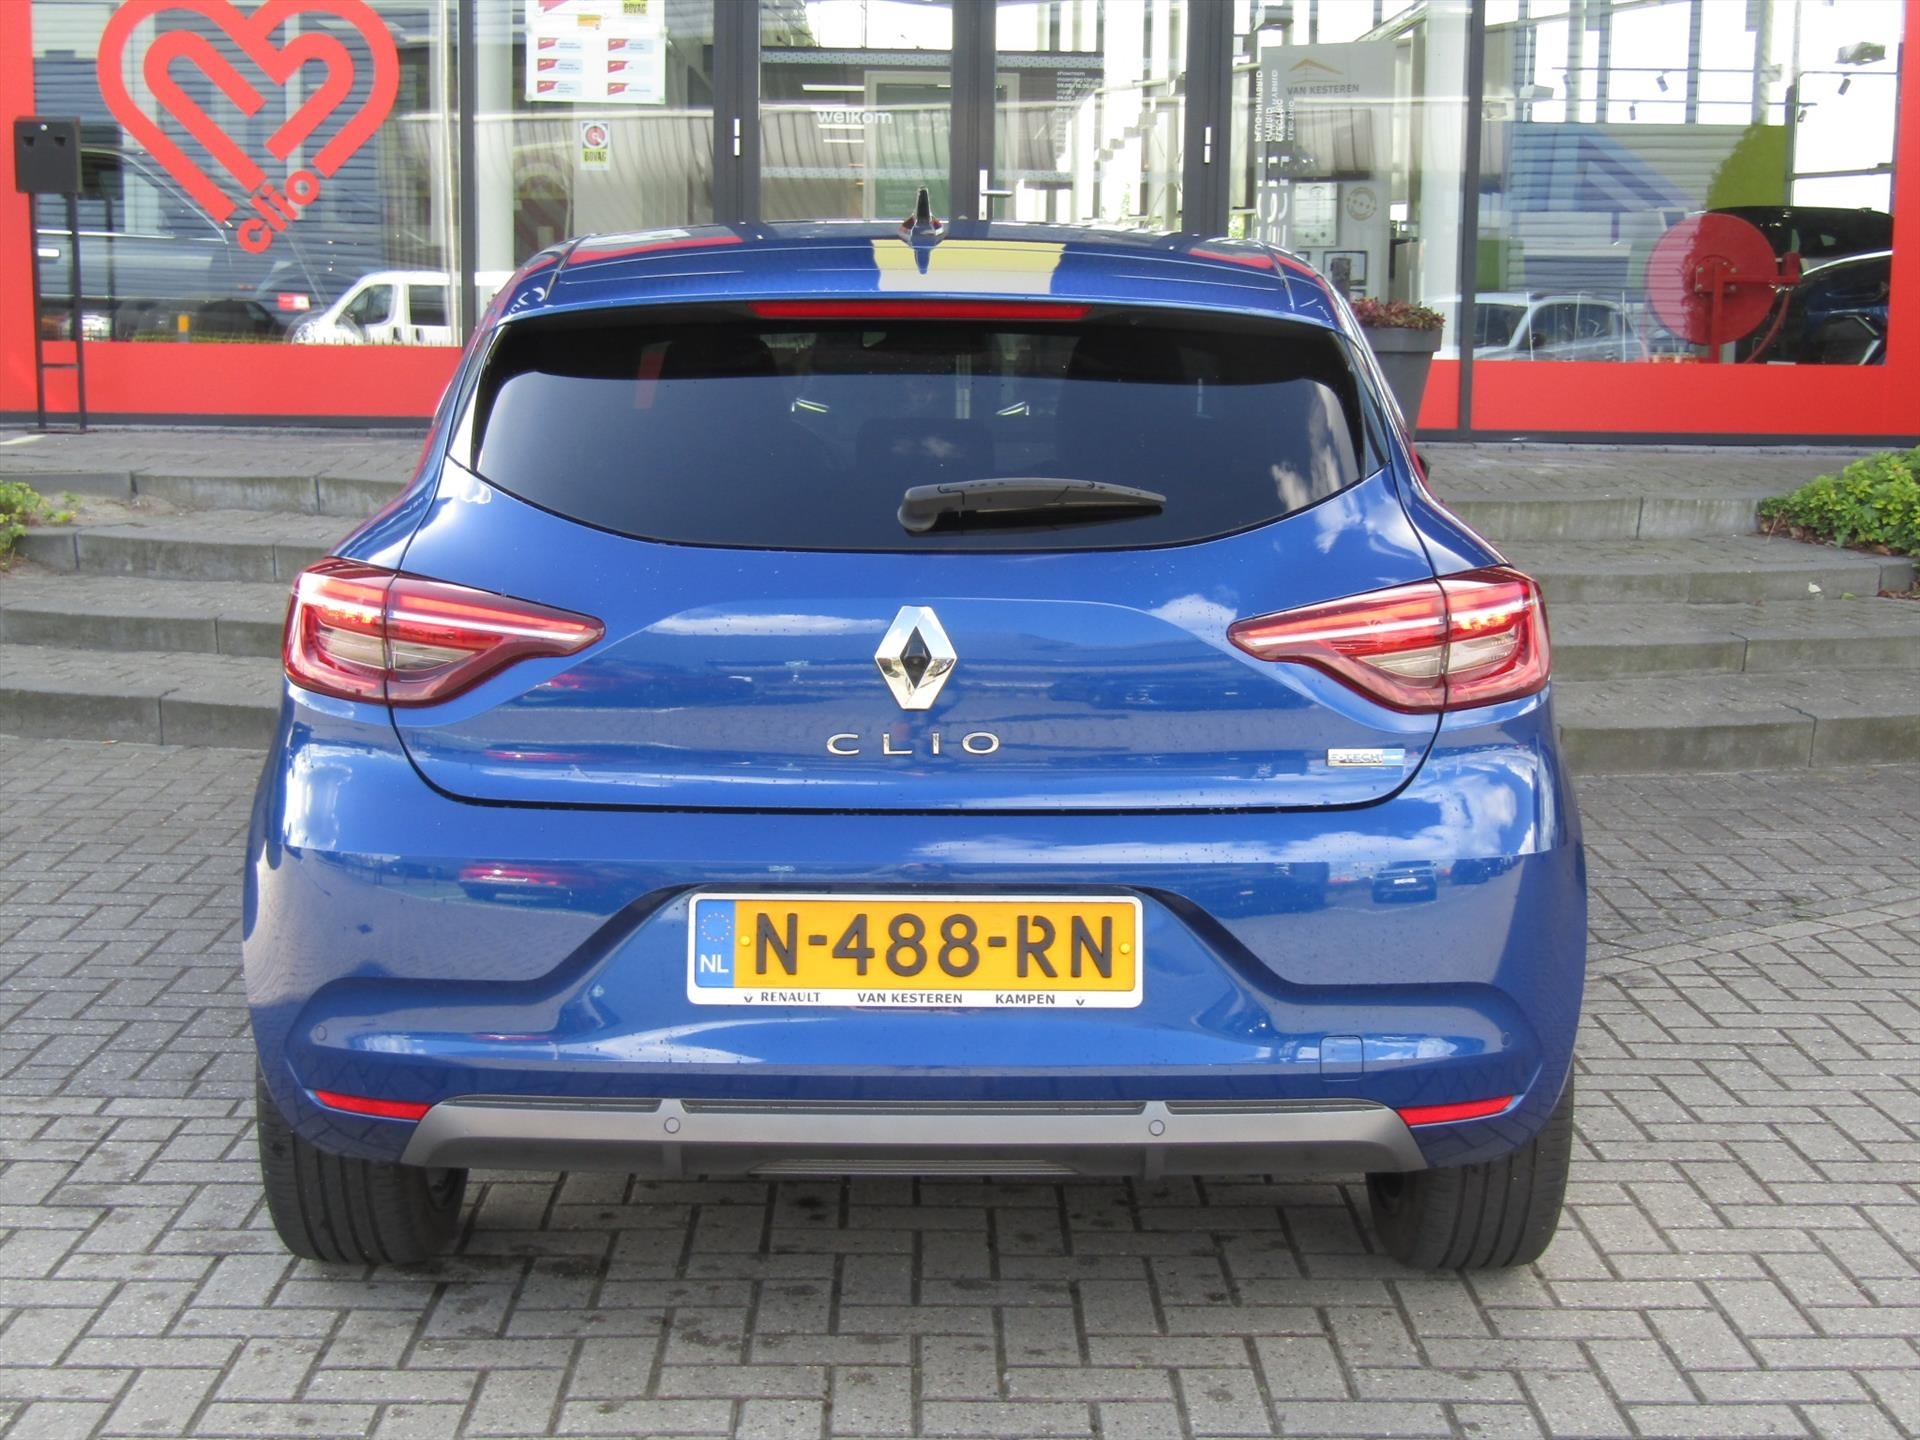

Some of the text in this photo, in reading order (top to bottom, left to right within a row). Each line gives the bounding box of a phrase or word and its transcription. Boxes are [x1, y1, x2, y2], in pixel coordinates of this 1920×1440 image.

[1287, 84, 1360, 95] VAN KESTEREN
[236, 170, 321, 255] clio
[826, 731, 1001, 755] CLIO
[755, 912, 1113, 979] N-488-RN
[700, 953, 729, 974] NL
[760, 991, 1055, 1005] RENAULT VAN KESTEREN KAMPEN
